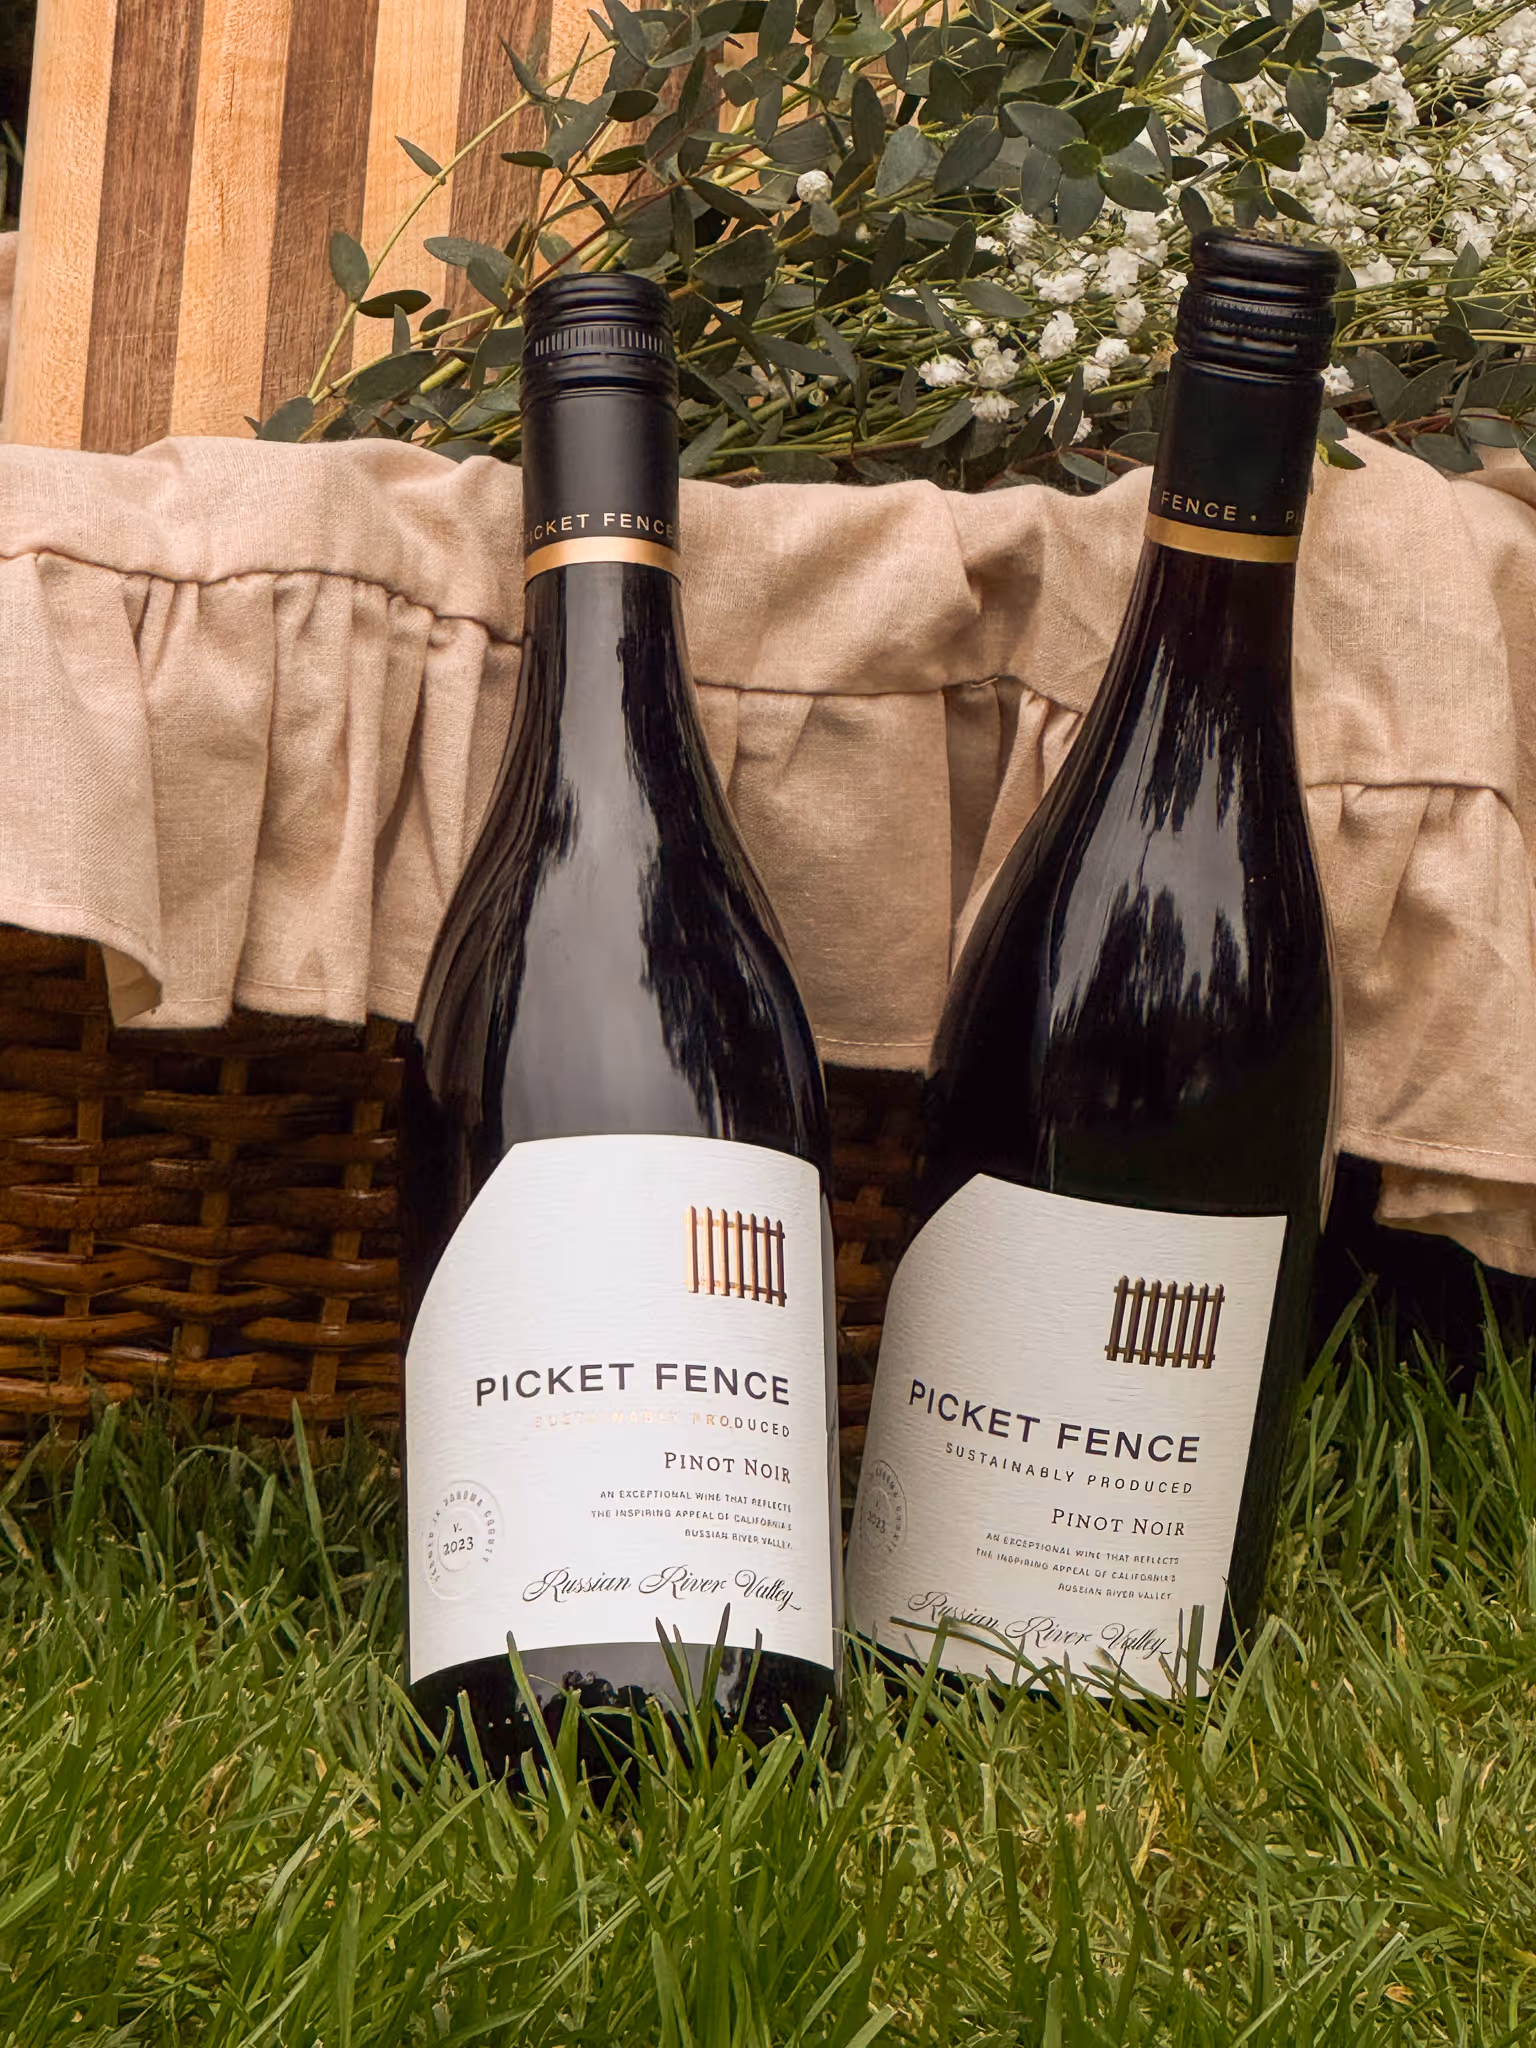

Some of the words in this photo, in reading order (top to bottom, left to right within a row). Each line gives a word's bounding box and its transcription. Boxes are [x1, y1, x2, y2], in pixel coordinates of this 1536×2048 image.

[1161, 490, 1237, 521] FENCE
[526, 513, 590, 544] ICKET
[602, 512, 675, 540] FENCE
[476, 1363, 635, 1407] PICKET
[655, 1363, 790, 1406] FENCE
[692, 1413, 790, 1438] PRODUCED
[908, 1379, 1041, 1443] PICKET
[1057, 1422, 1201, 1464] FENCE
[664, 1452, 735, 1473] PINOT
[744, 1458, 791, 1483] NOIR
[945, 1441, 1075, 1483] SUSTAINABLY
[1087, 1474, 1193, 1494] PRODUCED
[600, 1490, 615, 1499] AN
[619, 1490, 692, 1500] EXCEPTIONAL
[695, 1491, 722, 1502] WINE
[725, 1494, 748, 1504] THAT
[615, 1509, 671, 1518] INSPIRING
[675, 1510, 715, 1520] APPEAL
[1051, 1508, 1124, 1533] PINOT
[1131, 1518, 1186, 1536] NOIR
[443, 1536, 475, 1556] 2023
[684, 1529, 729, 1540] RUSSIAN
[732, 1533, 760, 1544] RIVER
[1003, 1536, 1070, 1556] EXCEPTIONAL
[1075, 1549, 1101, 1560] WINE
[1106, 1552, 1130, 1563] THAT
[1134, 1555, 1180, 1565] REFLECTS
[522, 1566, 632, 1604] Russian
[638, 1564, 727, 1601] River
[734, 1569, 802, 1612] Valley
[1004, 1616, 1093, 1648] River
[1100, 1622, 1173, 1660] Valley
